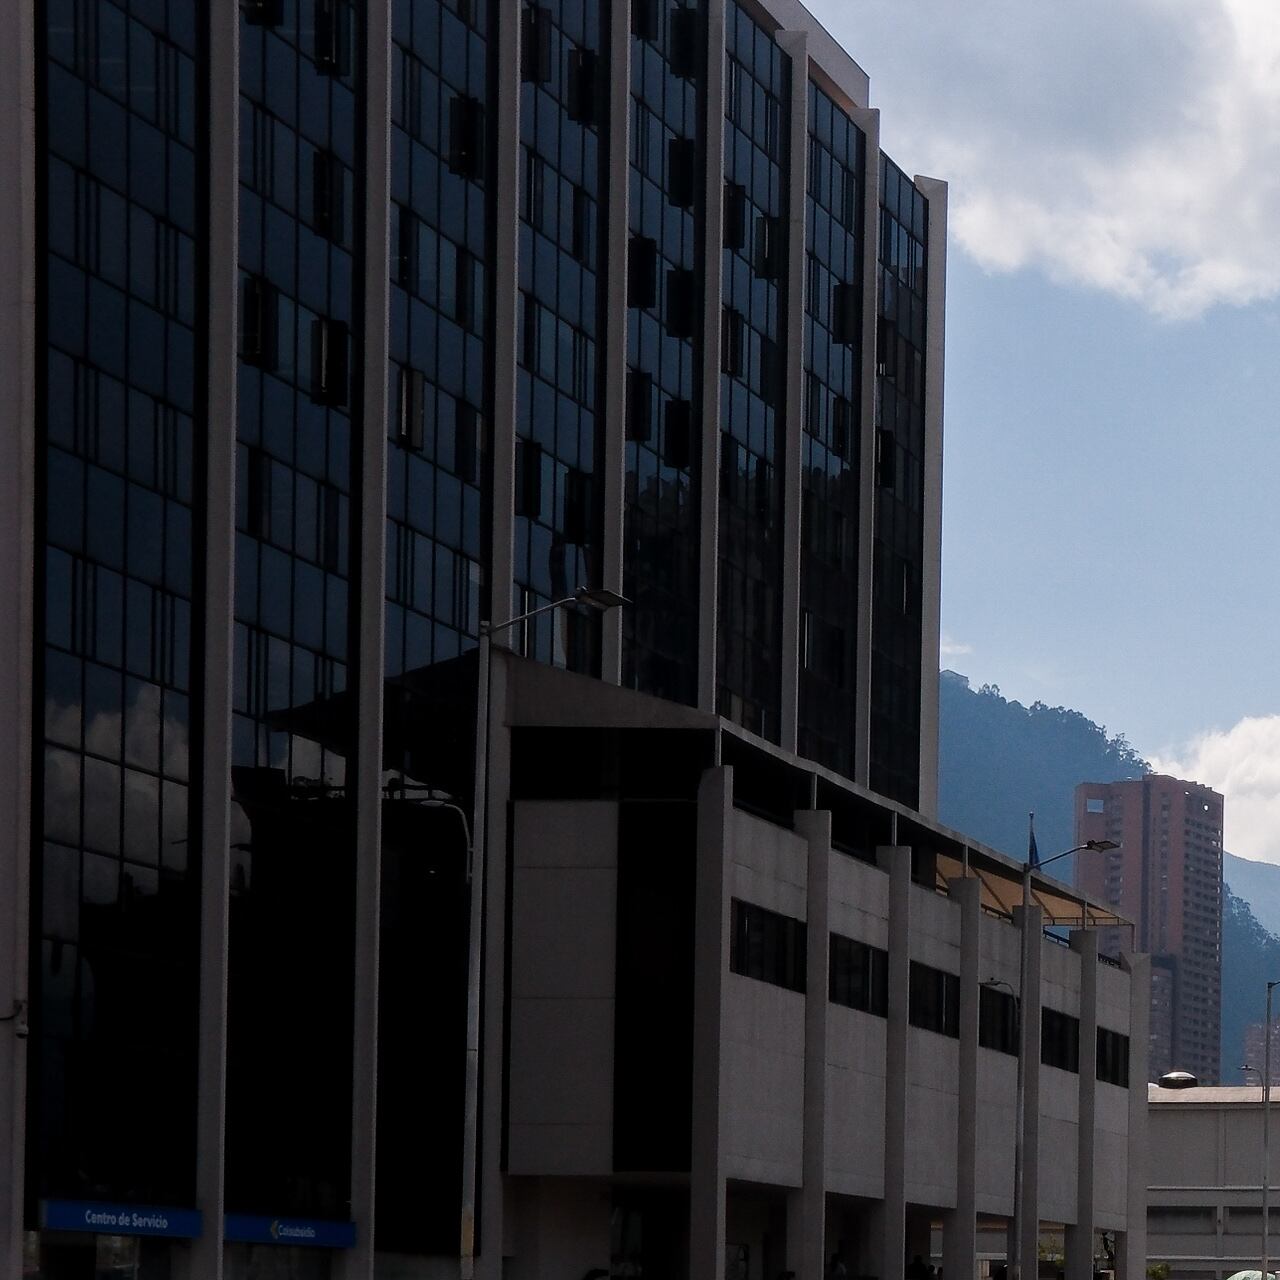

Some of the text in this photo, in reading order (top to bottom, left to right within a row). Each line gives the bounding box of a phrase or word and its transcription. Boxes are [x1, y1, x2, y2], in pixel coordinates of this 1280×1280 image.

[85, 1209, 168, 1229] Centro de Servicio
